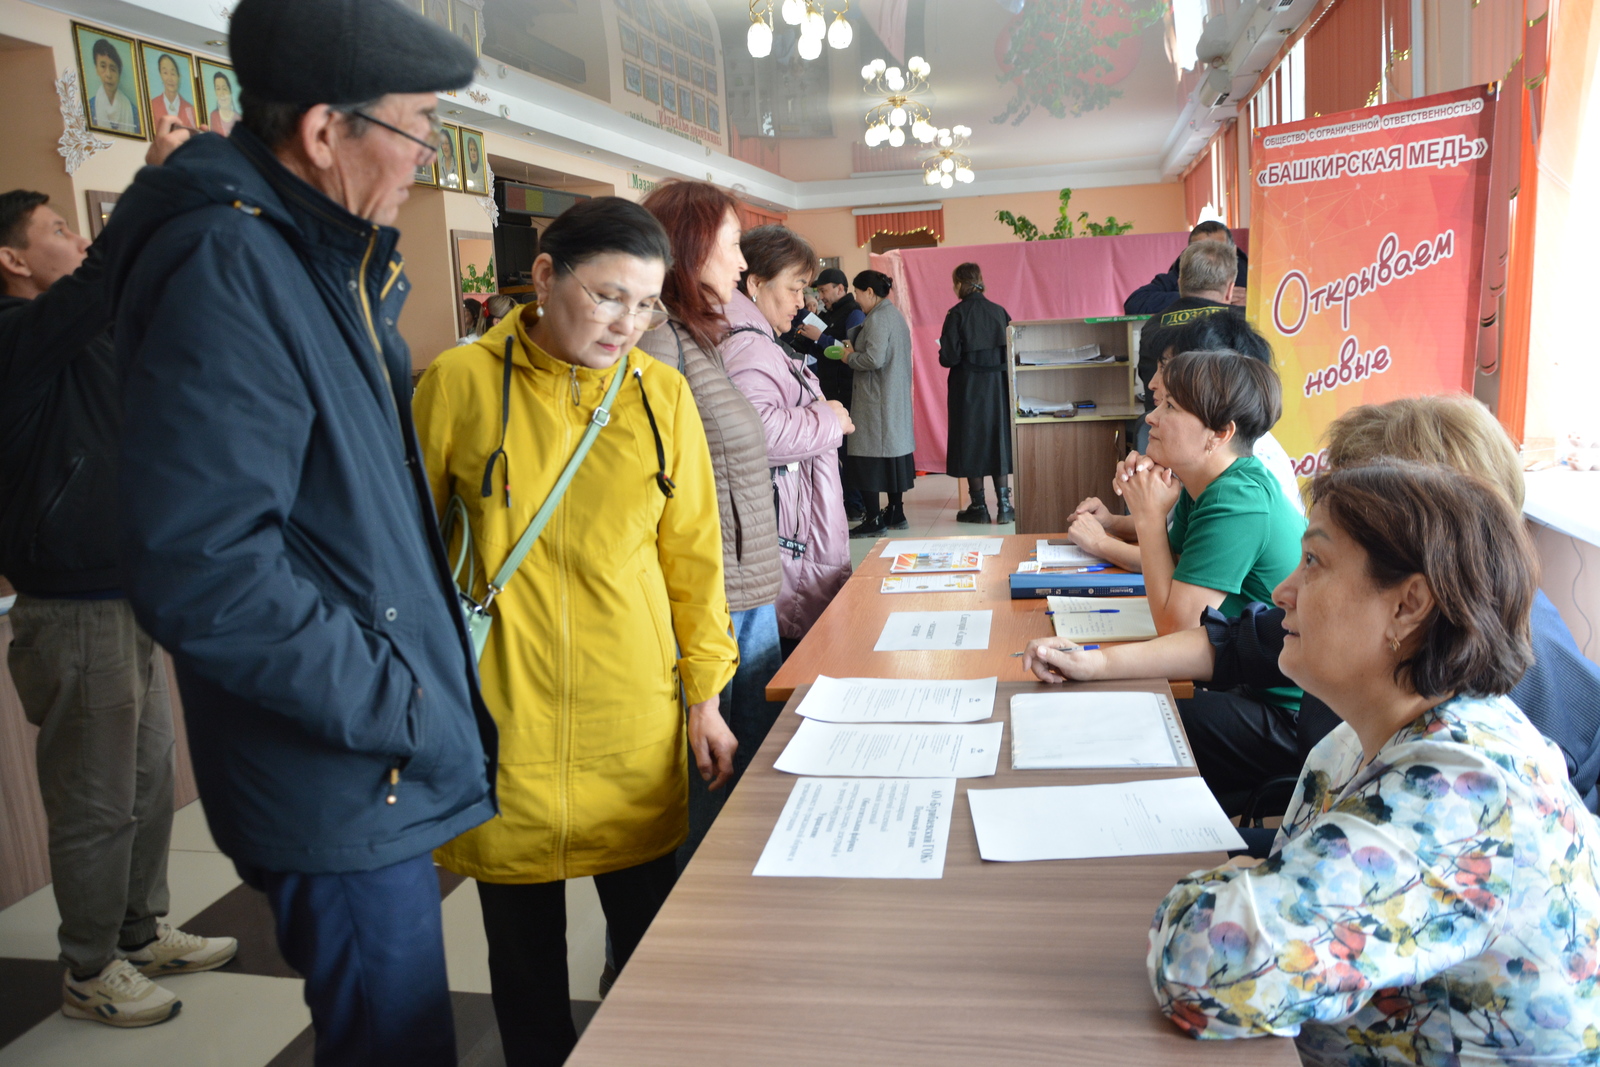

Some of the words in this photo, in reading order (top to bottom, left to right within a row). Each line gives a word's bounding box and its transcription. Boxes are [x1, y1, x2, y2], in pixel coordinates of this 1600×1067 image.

[1264, 132, 1306, 147] ОБЩЕСТВО
[1309, 128, 1315, 139] С
[1316, 118, 1380, 138] ОГРАНИЧЕННОЙ
[1383, 100, 1482, 127] ОТВЕТСТВЕННОСТЬЮ
[1258, 146, 1401, 185] «БАШКИРСКАЯ
[1409, 139, 1486, 168] МЕДЬ»
[1274, 232, 1452, 335] Открываем
[1305, 338, 1389, 396] новые
